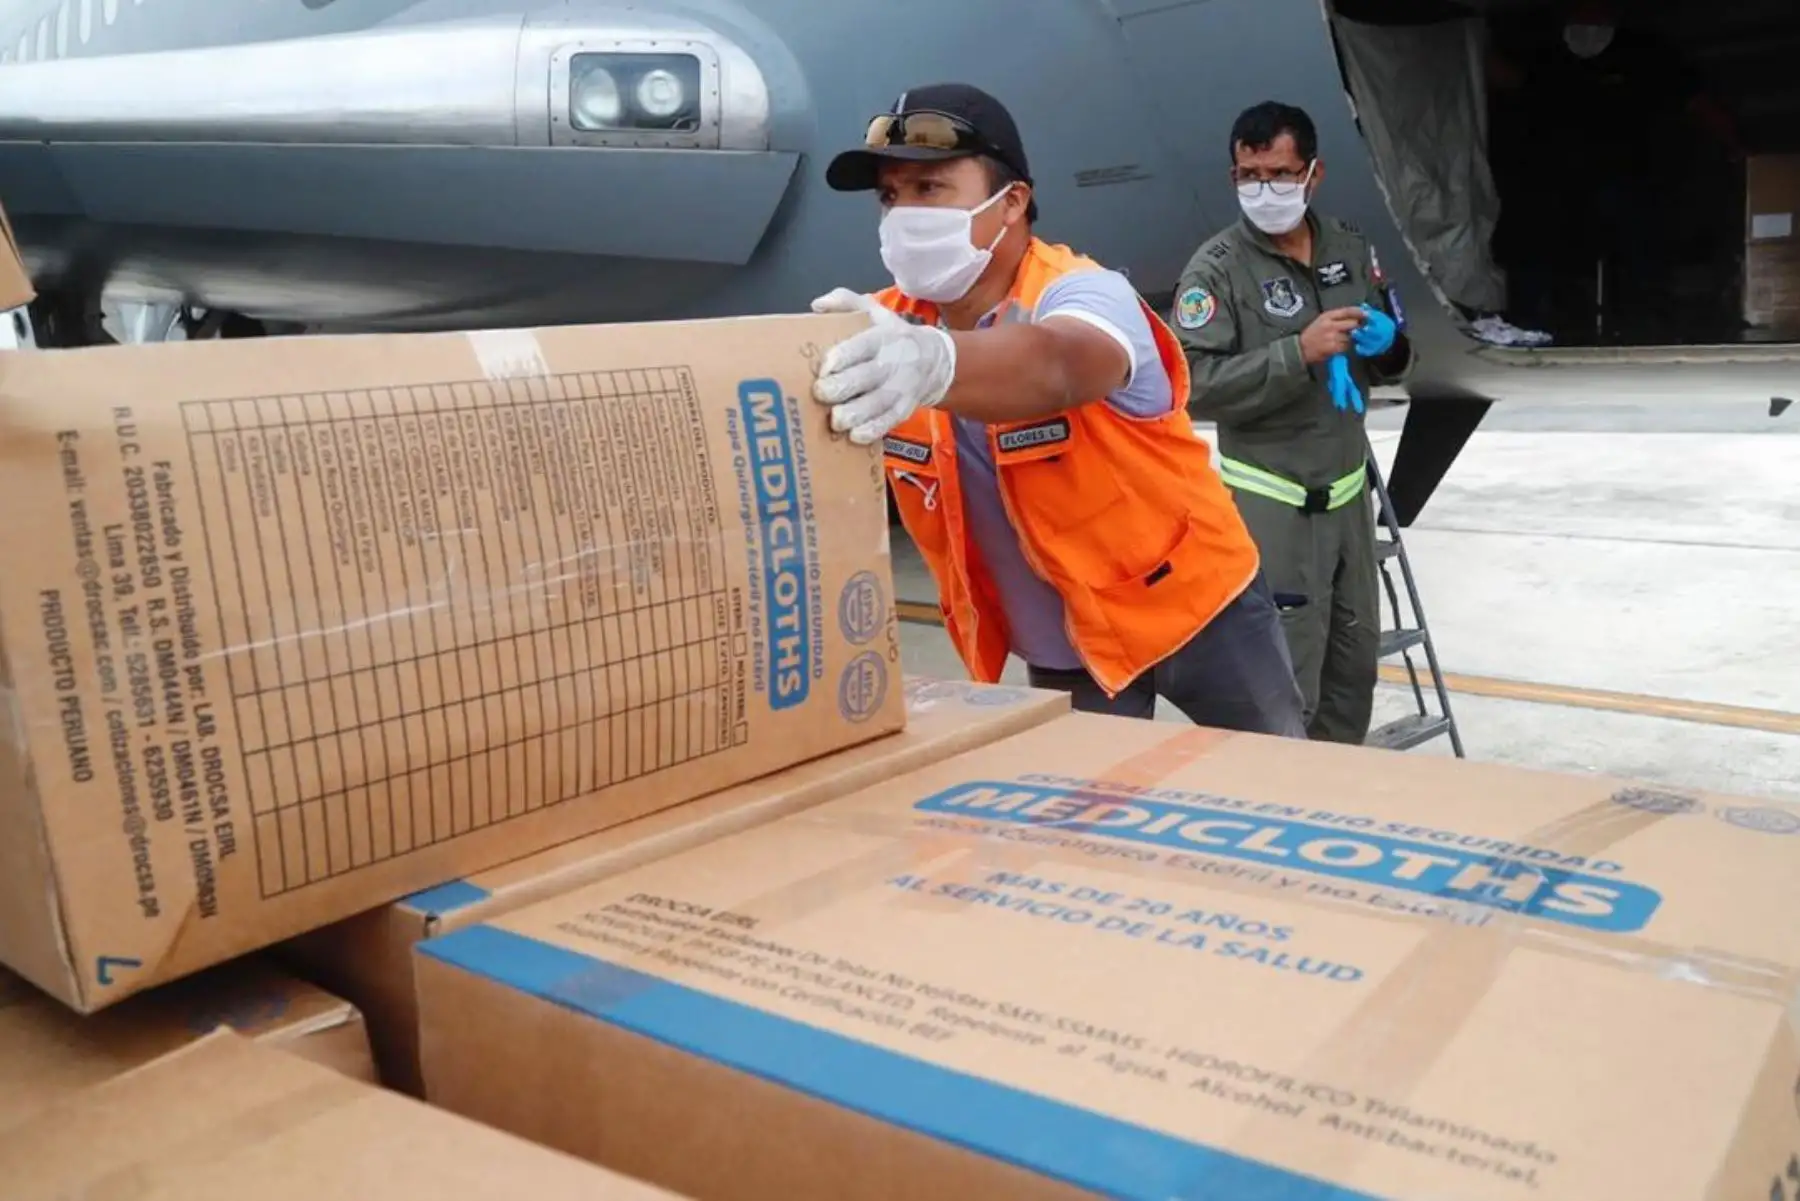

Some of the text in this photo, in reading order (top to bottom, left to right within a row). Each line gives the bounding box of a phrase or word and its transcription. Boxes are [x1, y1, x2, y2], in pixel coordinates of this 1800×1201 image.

[680, 372, 698, 423] NOMBRE
[692, 426, 703, 449] DEL
[1003, 431, 1045, 446] FLORES
[53, 429, 87, 494] E-mail:
[150, 460, 184, 548] Fabricado
[724, 407, 742, 450] Ropa
[751, 615, 763, 636] no
[747, 390, 800, 698] MEDICLOTHS
[785, 395, 814, 522] ESPECIALISTAS
[810, 583, 822, 680] SEGURIDAD
[66, 498, 122, 694] ventas@drocsac.com
[145, 596, 171, 636] R.S.
[168, 565, 203, 660] Distribuido
[38, 587, 94, 785] PRODUCTO PERUANO
[102, 523, 130, 569] Lima
[141, 744, 174, 823] 6235930
[152, 637, 187, 725] DM0444N
[182, 663, 206, 700] por:
[192, 701, 218, 743] LAB.
[103, 707, 161, 921] cotizaciones@drocsa.pe
[199, 744, 231, 820] DROCSA
[213, 820, 238, 862] EIRL
[937, 786, 1633, 920] MEDICLOTHS
[1252, 803, 1305, 817] EN
[1306, 811, 1376, 828] BIO
[1387, 823, 1623, 873] SEGURIDAD
[625, 893, 713, 918] DROCSA
[885, 875, 1364, 982] AL SERVICIO DE LA SALUD
[983, 871, 1294, 941] MAS DE 20 AÑOS
[1306, 883, 1358, 900] no
